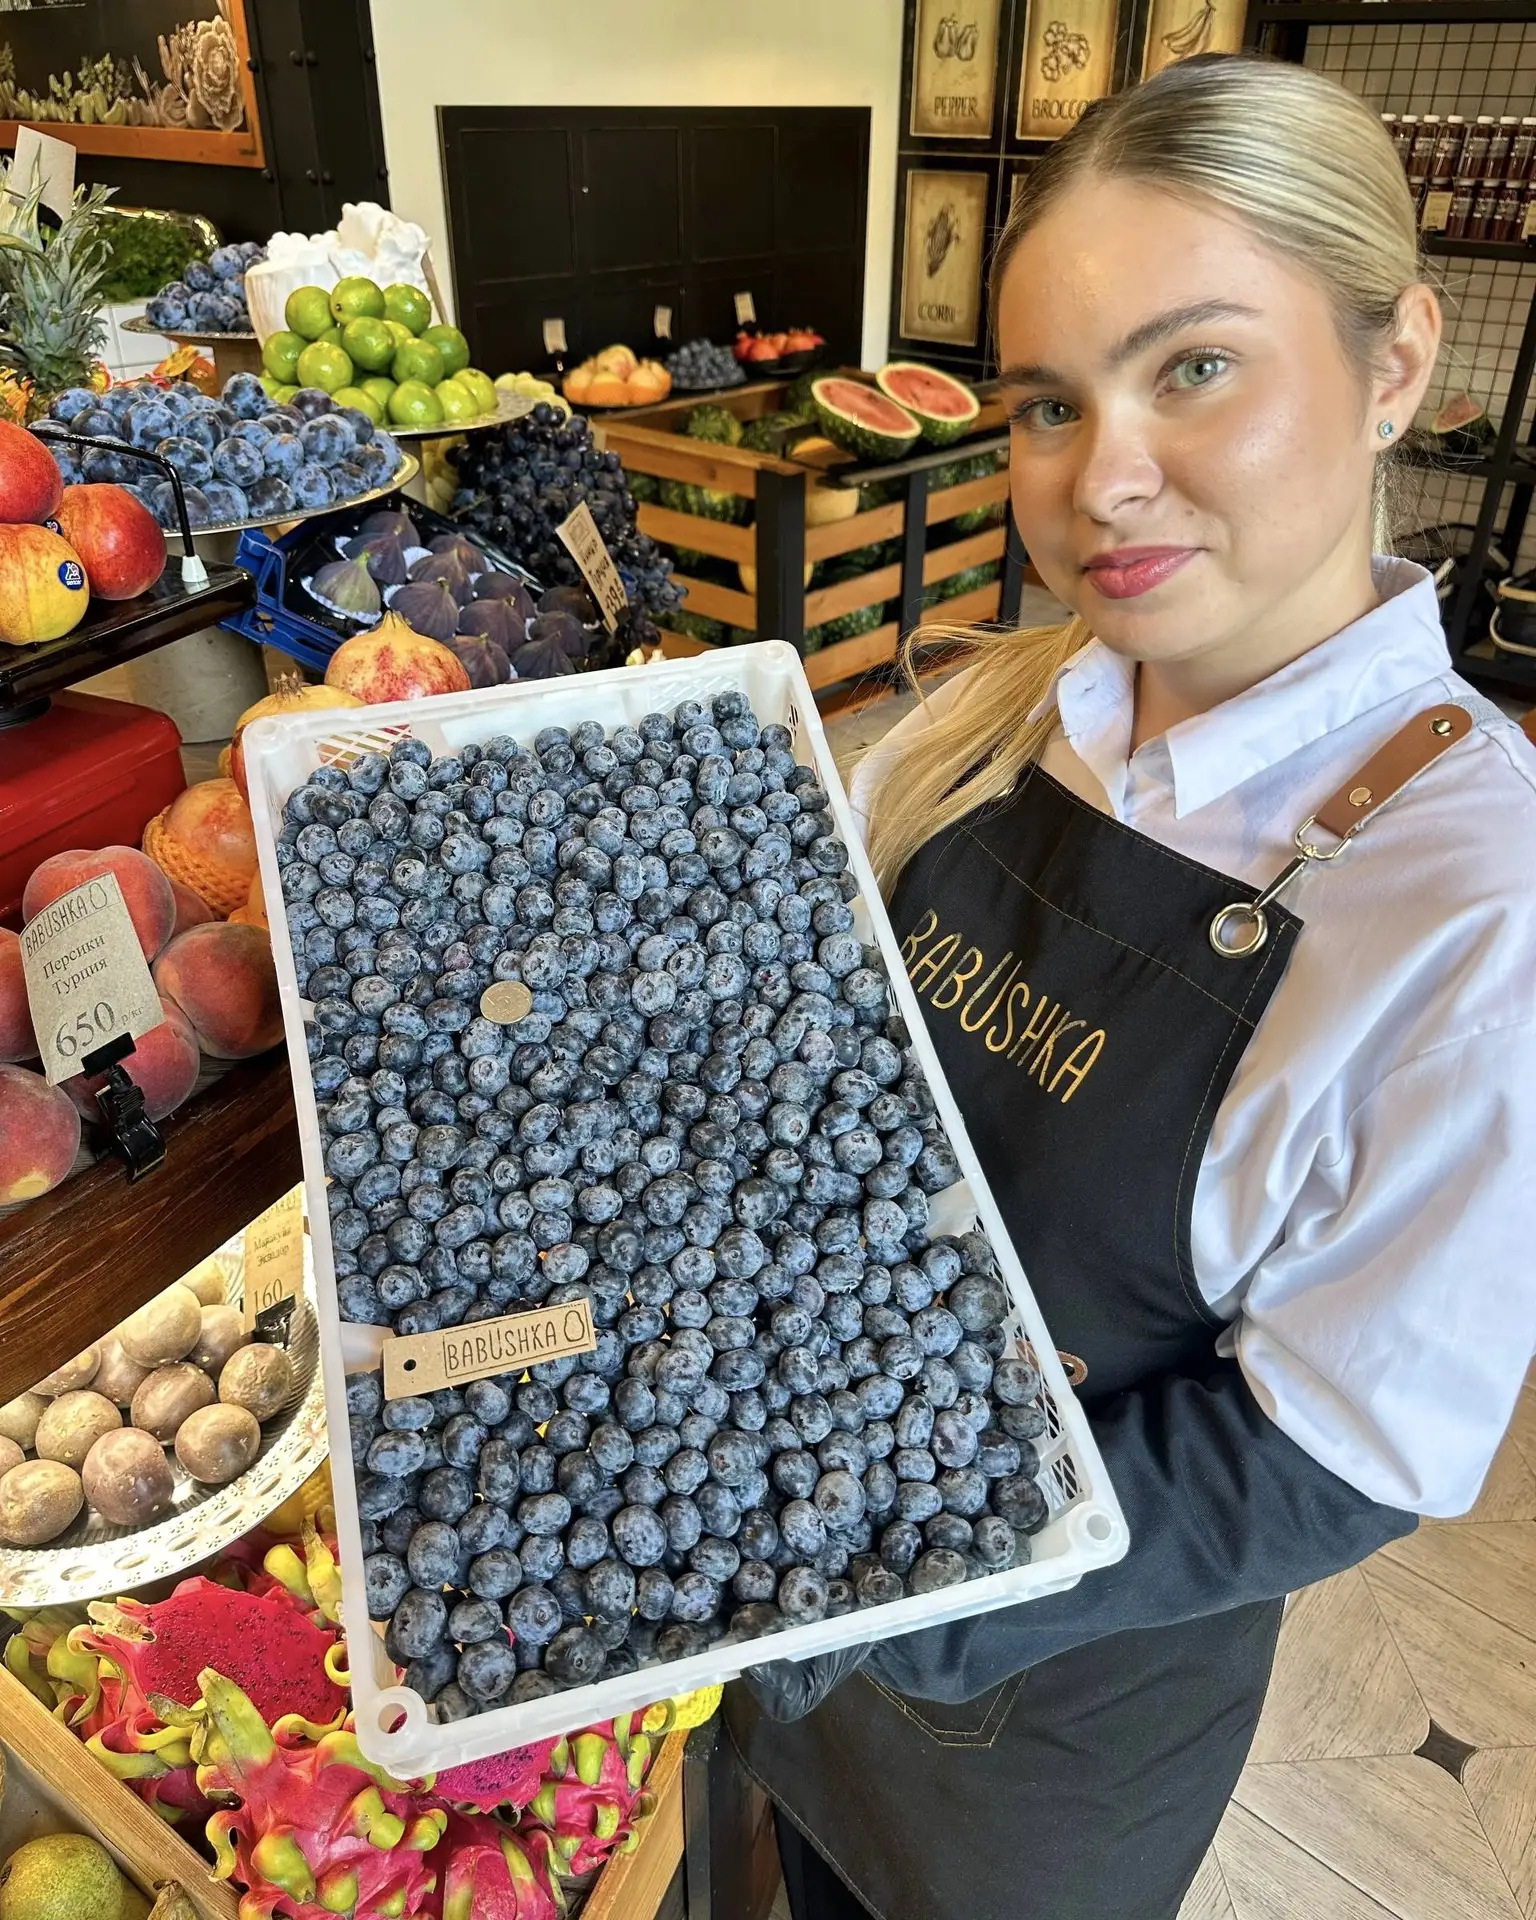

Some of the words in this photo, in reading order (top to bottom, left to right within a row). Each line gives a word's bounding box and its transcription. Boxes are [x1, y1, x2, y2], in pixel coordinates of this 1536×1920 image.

[934, 96, 978, 118] PEPPER
[917, 302, 956, 323] CORN
[25, 894, 89, 958] BABUSHKA
[42, 933, 106, 979] Персики
[52, 957, 109, 995] Турция
[900, 908, 1106, 1103] BABUSHKA
[55, 1001, 116, 1057] 650
[253, 1278, 283, 1310] 160
[446, 1321, 557, 1371] BABUSHKA
